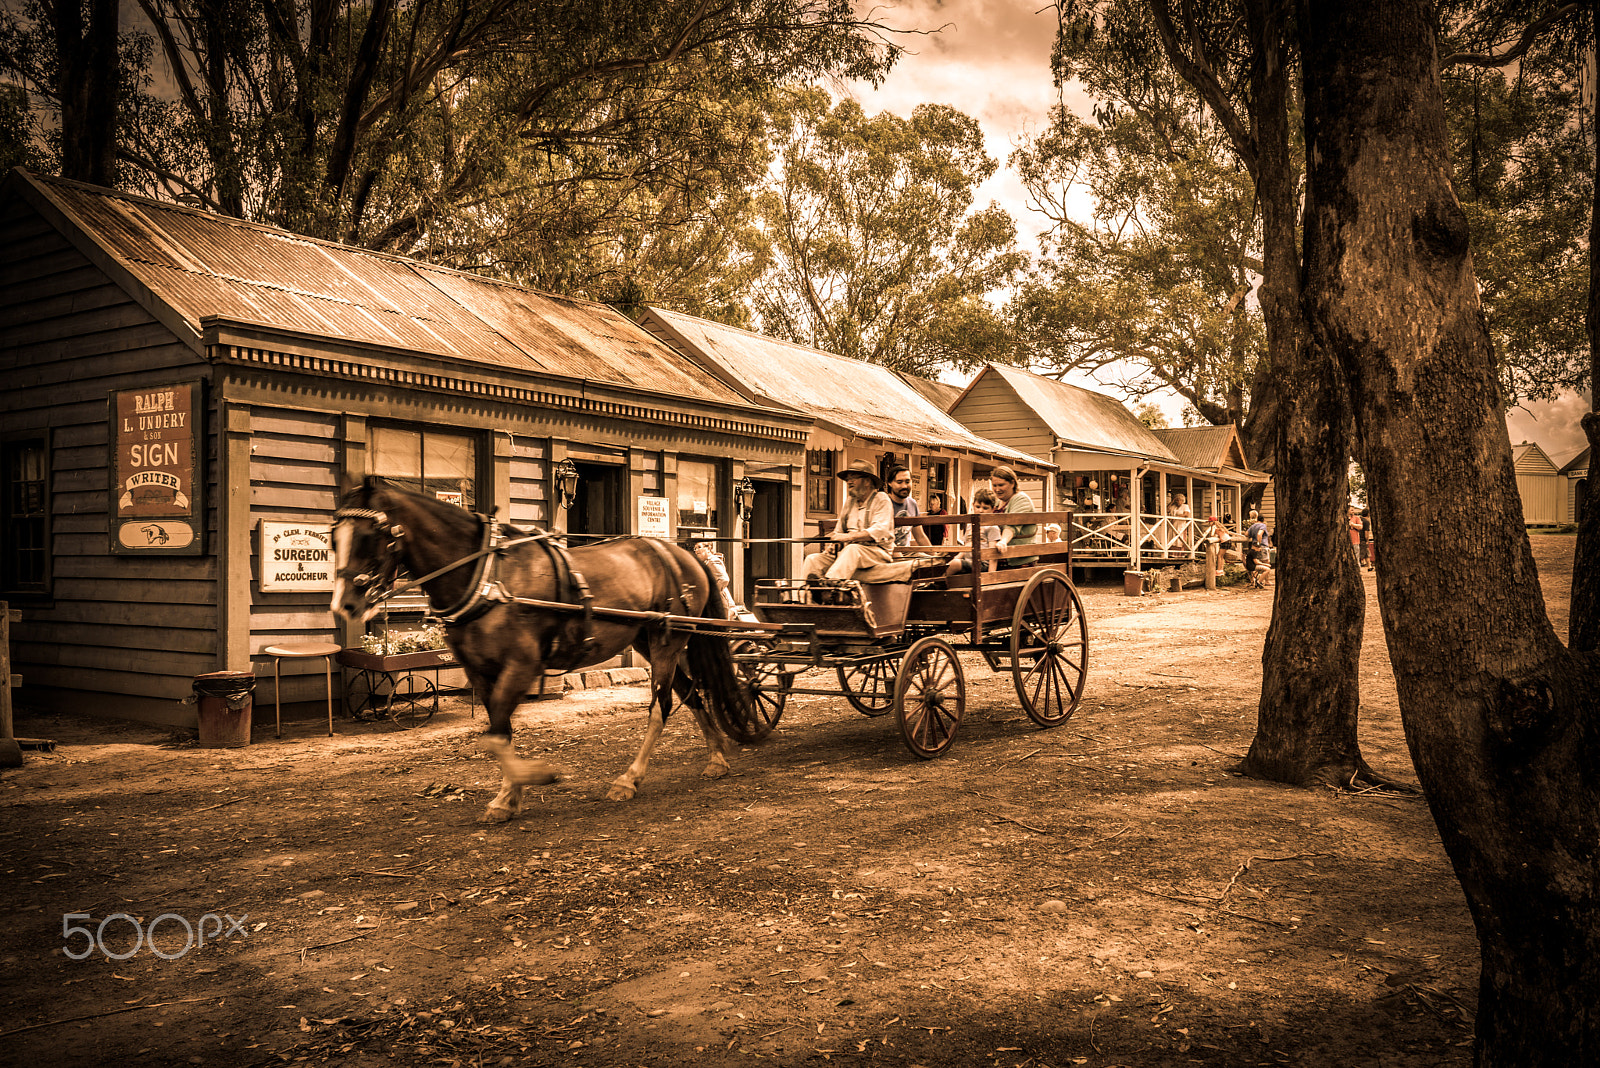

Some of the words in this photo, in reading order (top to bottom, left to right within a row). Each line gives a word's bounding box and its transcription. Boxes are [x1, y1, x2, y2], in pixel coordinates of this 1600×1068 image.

[135, 391, 175, 413] RALPH
[124, 418, 134, 433] L.
[139, 412, 186, 431] UNDERY
[143, 431, 149, 441] &
[150, 431, 162, 440] SON
[130, 442, 178, 467] SIGN
[131, 472, 177, 488] WRITER
[273, 549, 328, 561] SURGEON
[297, 562, 304, 572] &
[274, 572, 328, 581] ACCOUCHEUR
